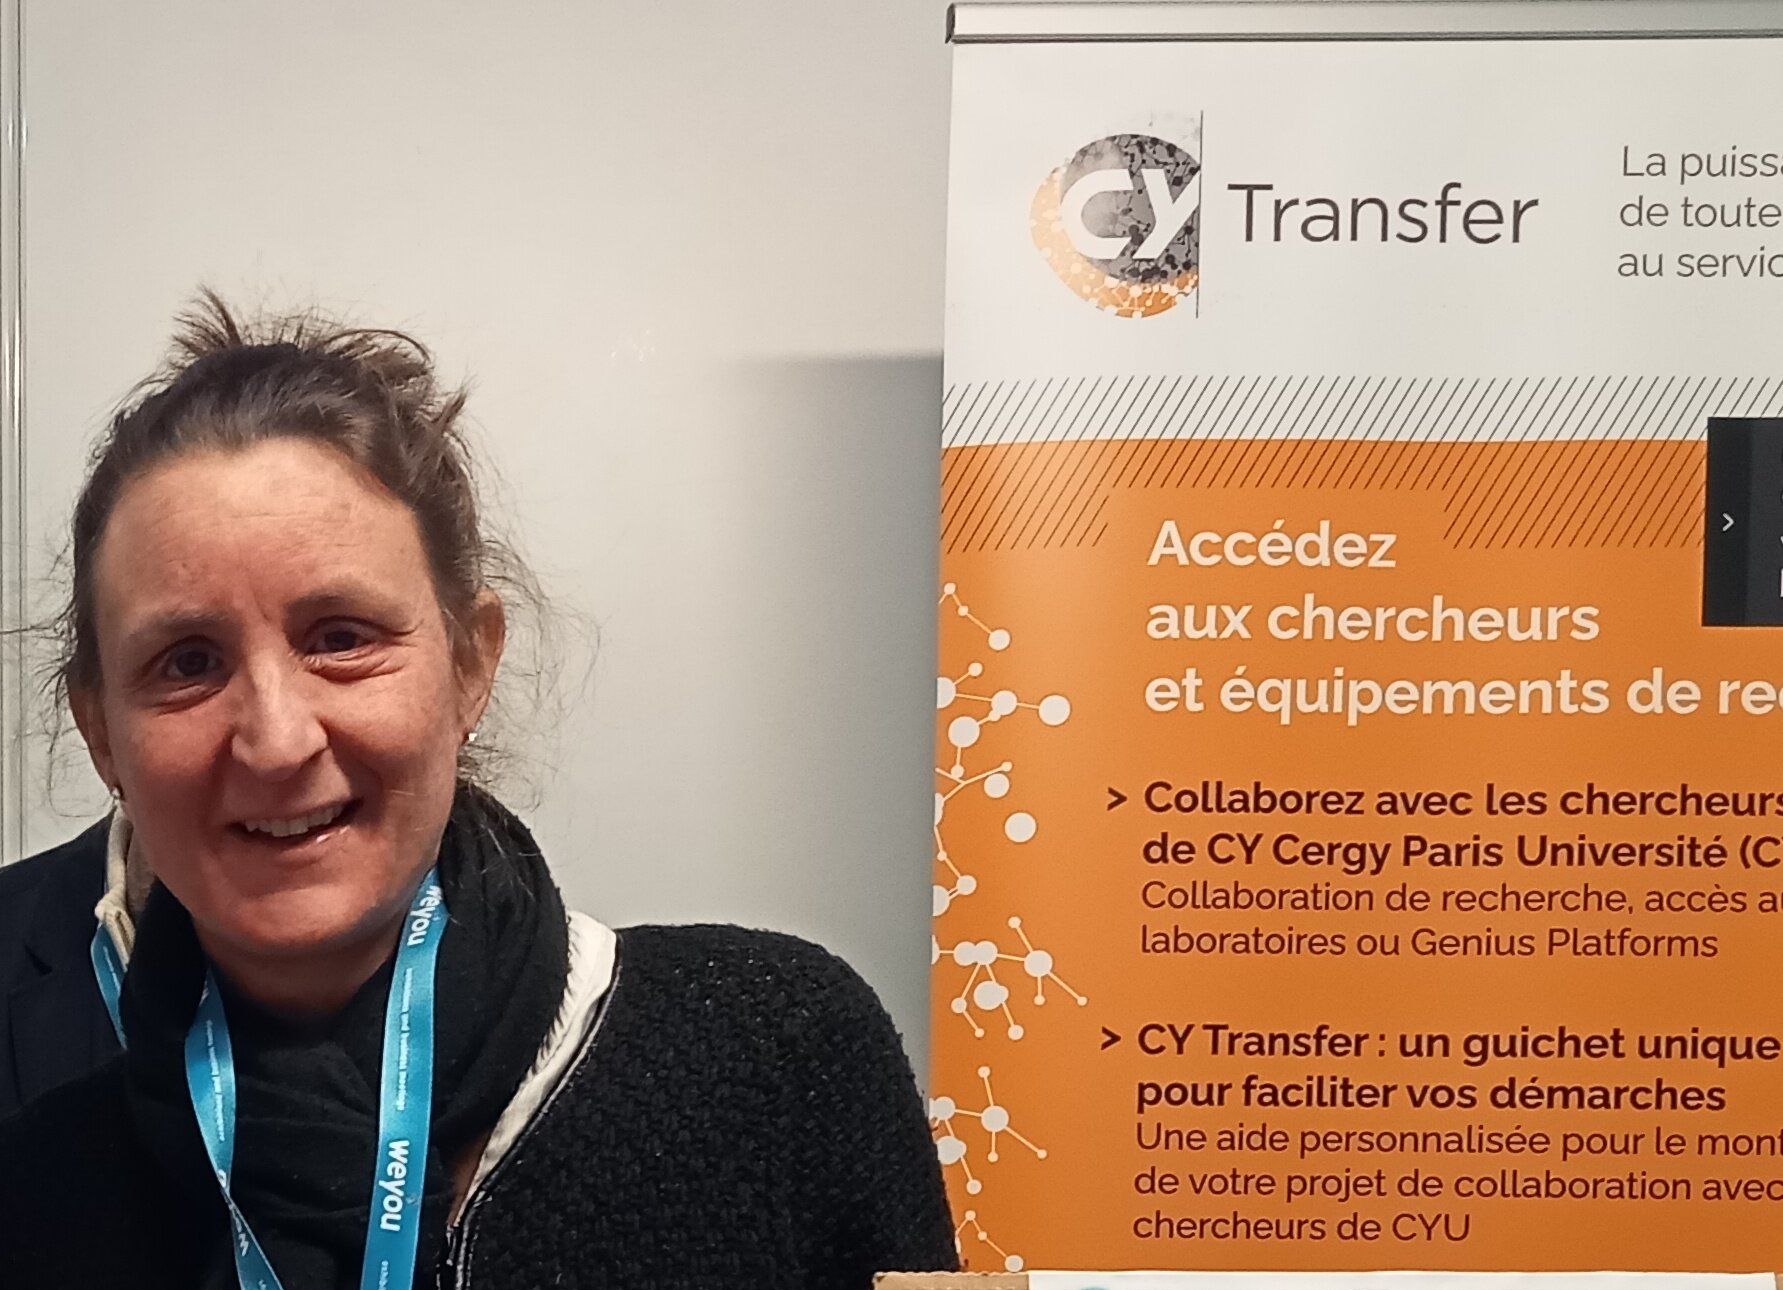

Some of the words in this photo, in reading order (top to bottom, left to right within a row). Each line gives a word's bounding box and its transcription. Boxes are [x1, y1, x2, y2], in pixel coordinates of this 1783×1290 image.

[1624, 146, 1666, 176] La
[1681, 145, 1783, 185] puiss
[1228, 182, 1538, 244] Transfer
[1620, 195, 1668, 226] de
[1681, 197, 1781, 227] toute
[1618, 254, 1663, 277] au
[1148, 520, 1396, 567] Accédez
[1147, 605, 1252, 638] aux
[1268, 593, 1599, 641] chercheurs
[1146, 669, 1203, 711] et
[1221, 666, 1609, 725] équipements
[1627, 668, 1701, 714] de
[1719, 681, 1783, 714] re
[1145, 781, 1364, 814] Collaborez
[1376, 792, 1472, 815] avec
[1487, 783, 1547, 815] les
[1143, 832, 1195, 864] de
[1208, 833, 1263, 864] CY
[1273, 834, 1391, 875] Cergy
[1403, 835, 1503, 866] Paris
[1518, 834, 1727, 867] Université
[1740, 835, 1780, 869] (C
[407, 884, 442, 947] weyou
[1142, 881, 1373, 910] Collaboration
[1386, 883, 1430, 911] de
[1442, 883, 1633, 914] recherche,
[1645, 884, 1747, 912] accès
[1759, 892, 1783, 912] a
[1142, 925, 1345, 955] laboratoires
[1357, 935, 1399, 955] ou
[1412, 928, 1535, 955] Genius
[1549, 928, 1718, 957] Platforms
[1138, 1024, 1195, 1055] CY
[1203, 1024, 1369, 1057] Transfer
[1400, 1034, 1449, 1057] un
[1464, 1026, 1625, 1066] guichet
[1638, 1027, 1780, 1068] unique
[1137, 1083, 1232, 1114] pour
[1242, 1075, 1397, 1107] faciliter
[1406, 1085, 1477, 1108] vos
[1490, 1077, 1725, 1111] démarches
[1137, 1122, 1206, 1150] Une
[1217, 1123, 1289, 1151] aide
[1300, 1125, 1550, 1159] personnalisée
[1563, 1133, 1645, 1161] pour
[1656, 1126, 1686, 1155] le
[378, 1140, 411, 1232] weyou
[1135, 1166, 1179, 1194] de
[1189, 1168, 1276, 1195] votre
[1287, 1168, 1387, 1203] projet
[1398, 1169, 1443, 1197] de
[1455, 1170, 1690, 1199] collaboration
[1703, 1180, 1783, 1201] avec
[1134, 1210, 1326, 1240] chercheurs
[1337, 1212, 1381, 1240] de
[1393, 1214, 1469, 1241] CYU
